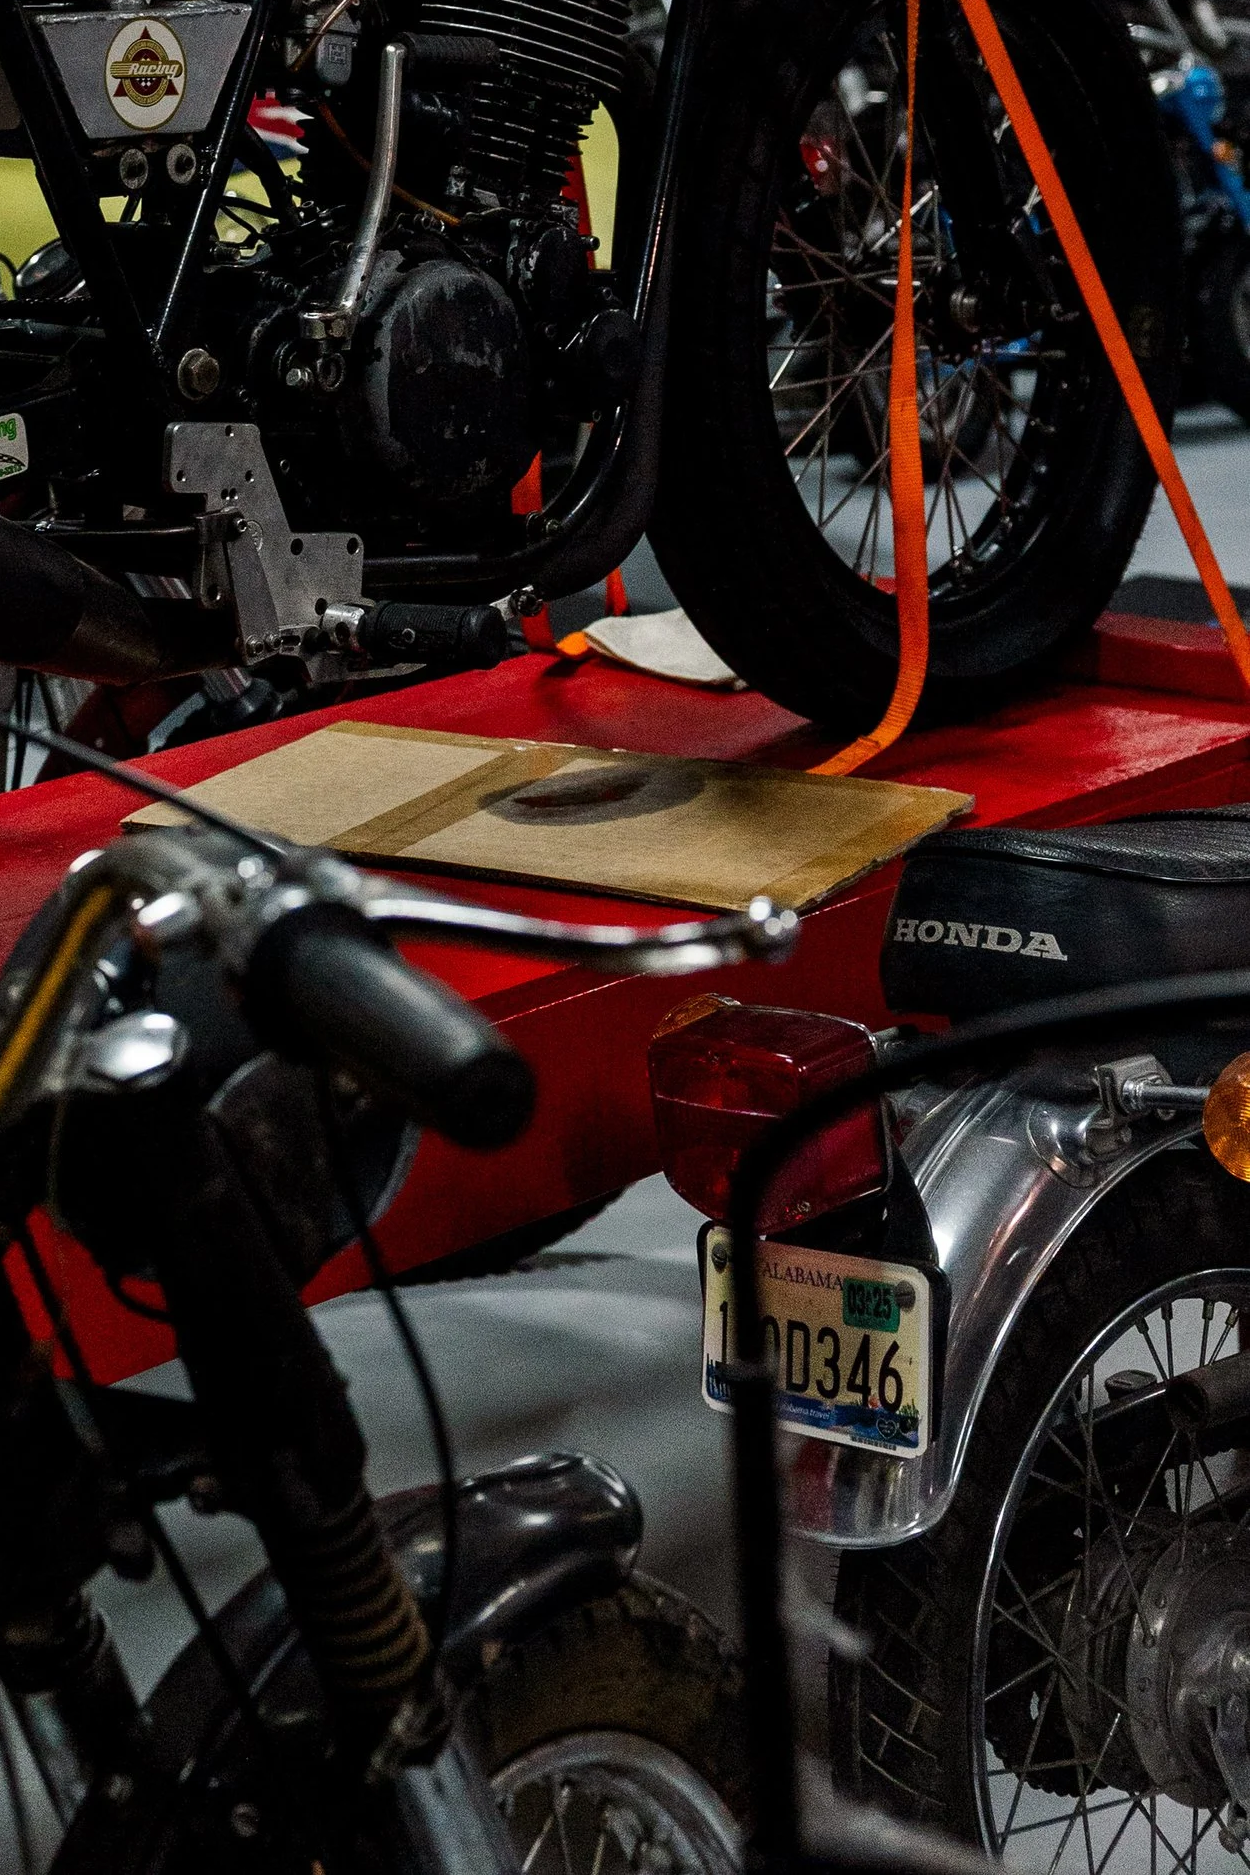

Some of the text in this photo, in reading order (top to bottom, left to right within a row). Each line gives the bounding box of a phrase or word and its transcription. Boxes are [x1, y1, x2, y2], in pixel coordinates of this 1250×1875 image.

[127, 61, 178, 80] Racing
[893, 917, 1069, 962] HONDA
[762, 1261, 844, 1291] ALABAMA
